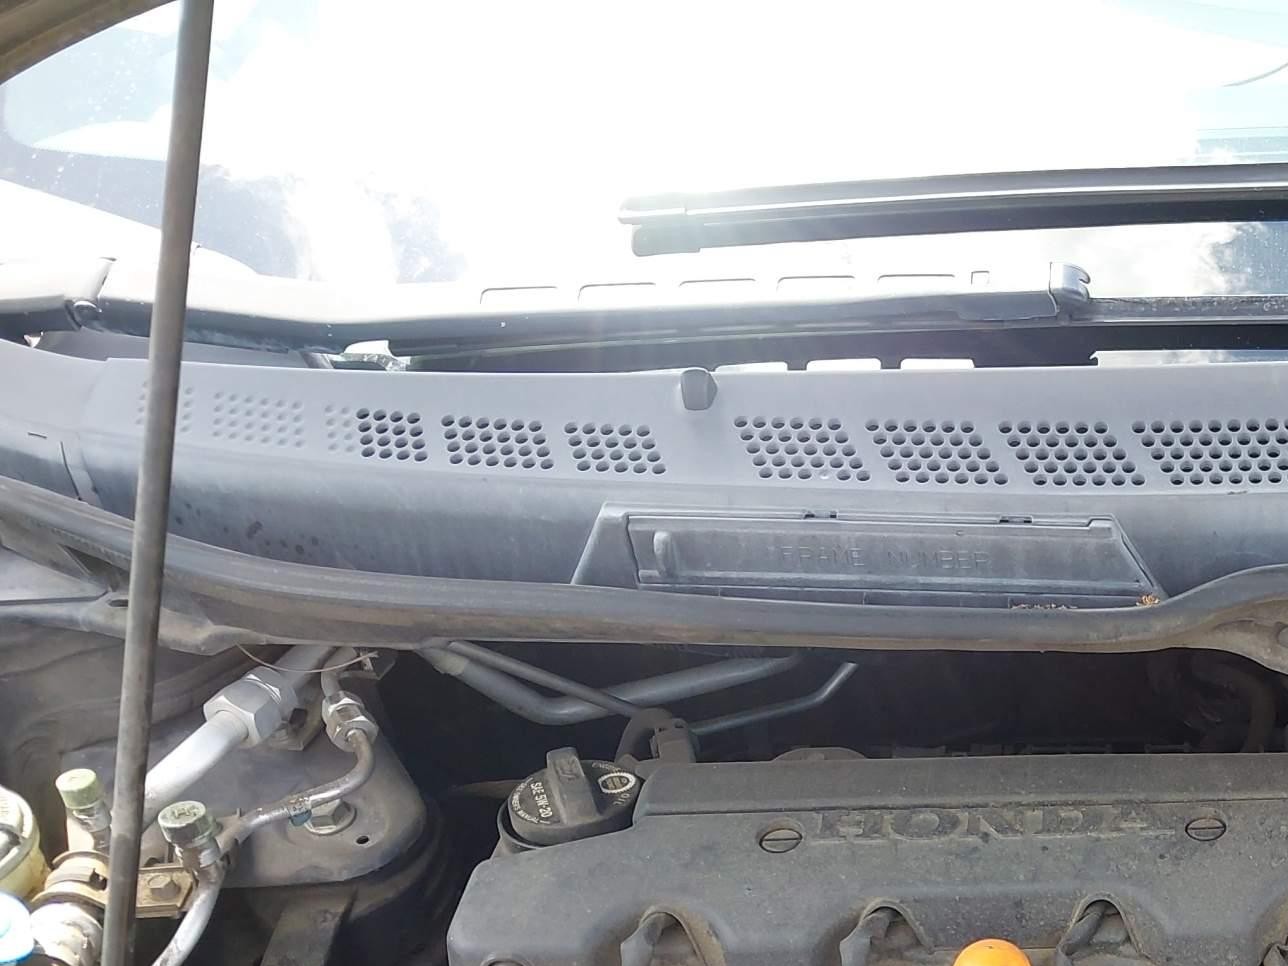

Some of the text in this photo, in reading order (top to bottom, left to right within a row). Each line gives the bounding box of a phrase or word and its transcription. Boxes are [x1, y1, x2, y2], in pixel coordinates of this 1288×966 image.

[779, 545, 990, 571] FRAME NUMBER
[535, 793, 553, 818] 5W-20
[812, 808, 1172, 844] HONDA
